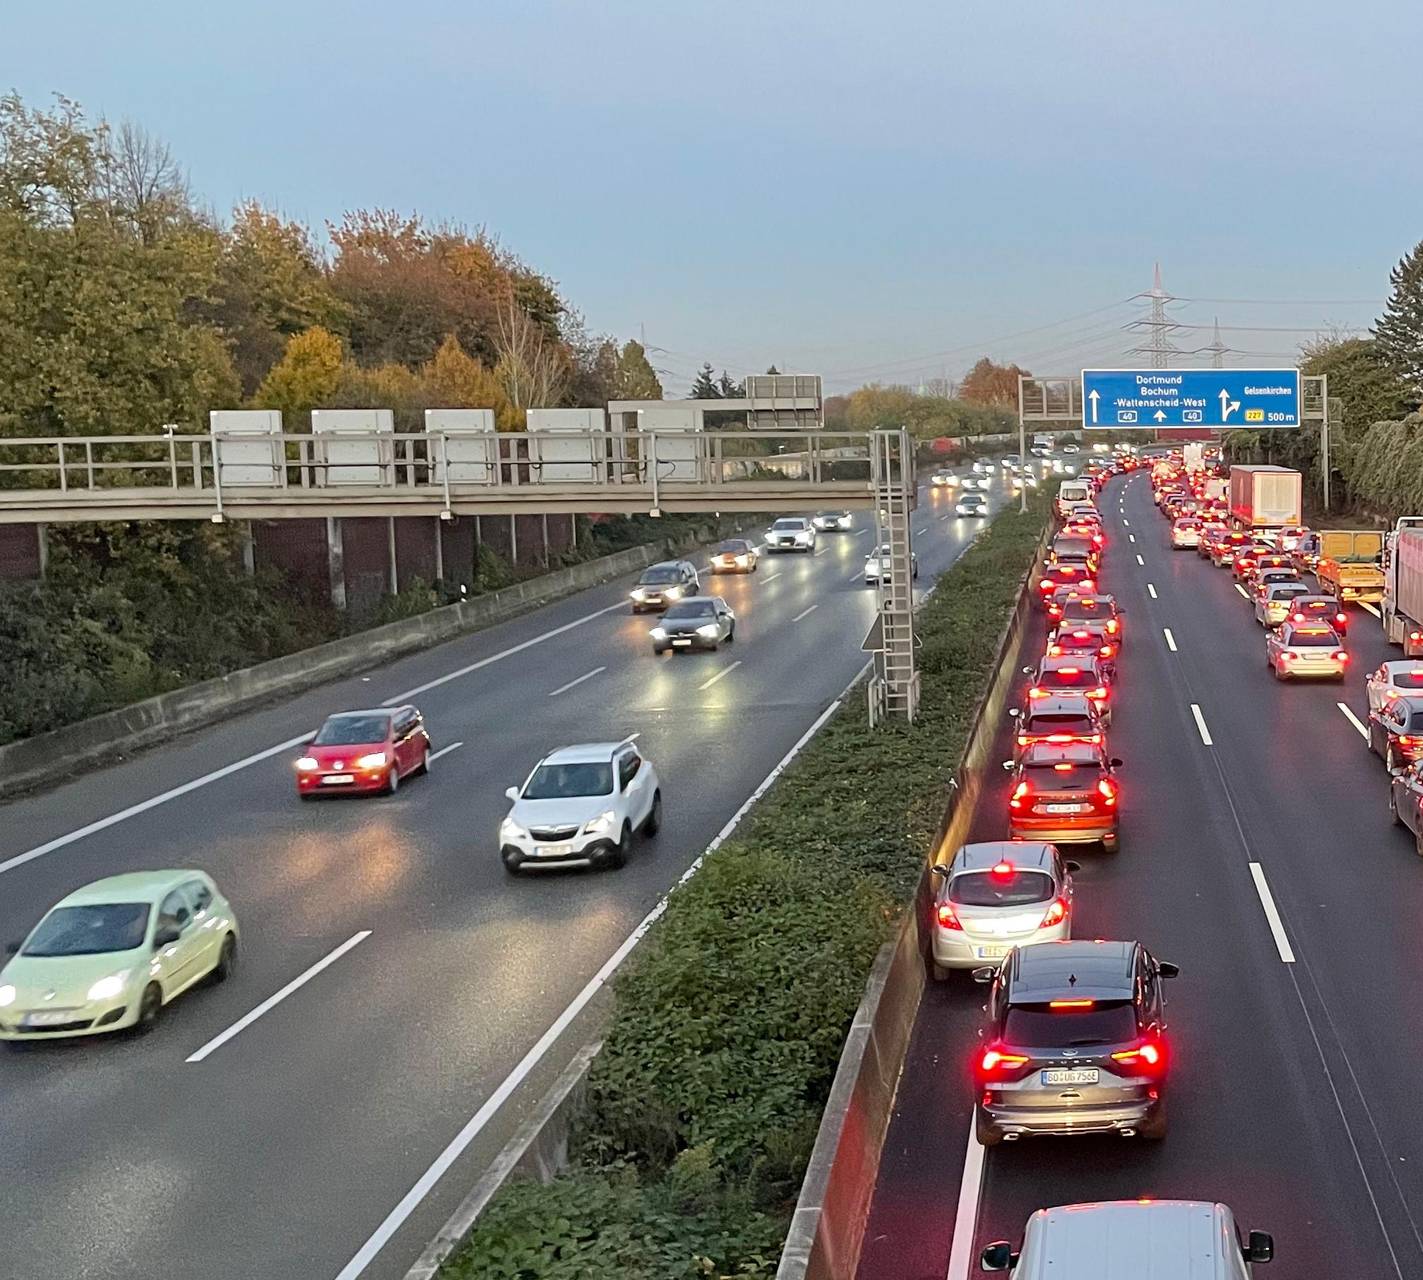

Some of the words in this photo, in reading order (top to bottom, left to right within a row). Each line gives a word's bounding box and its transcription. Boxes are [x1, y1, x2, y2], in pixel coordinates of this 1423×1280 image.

[1136, 375, 1182, 385] Dortmund
[1140, 386, 1178, 396] Bochum
[1244, 386, 1292, 395] Gelsenkirchen
[1122, 412, 1133, 420] 40
[1187, 412, 1198, 420] 40
[1248, 411, 1262, 419] 227
[1267, 412, 1285, 421] 500
